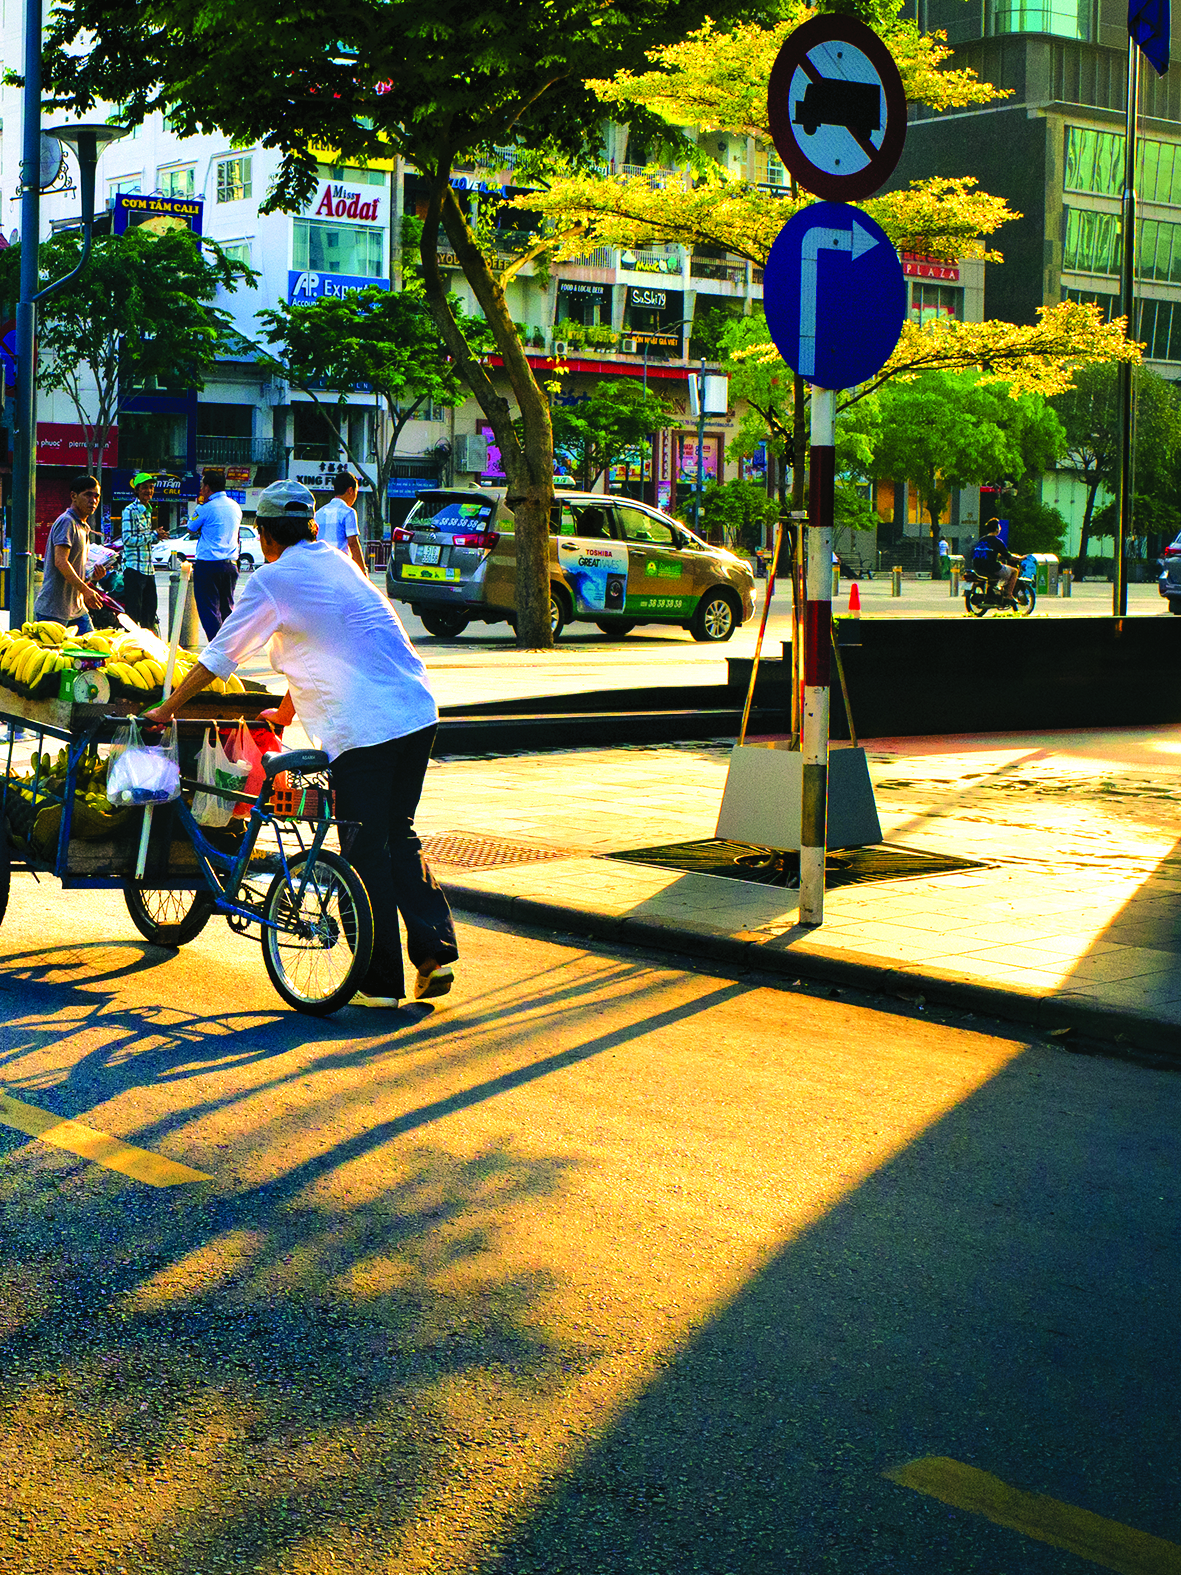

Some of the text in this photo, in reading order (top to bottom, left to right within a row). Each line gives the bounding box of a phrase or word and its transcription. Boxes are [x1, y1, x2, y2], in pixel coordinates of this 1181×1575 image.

[333, 184, 356, 200] Miss
[121, 198, 200, 214] CƠM TẤM CALI
[906, 263, 956, 280] PLAZA
[585, 549, 613, 557] TOSHIBA
